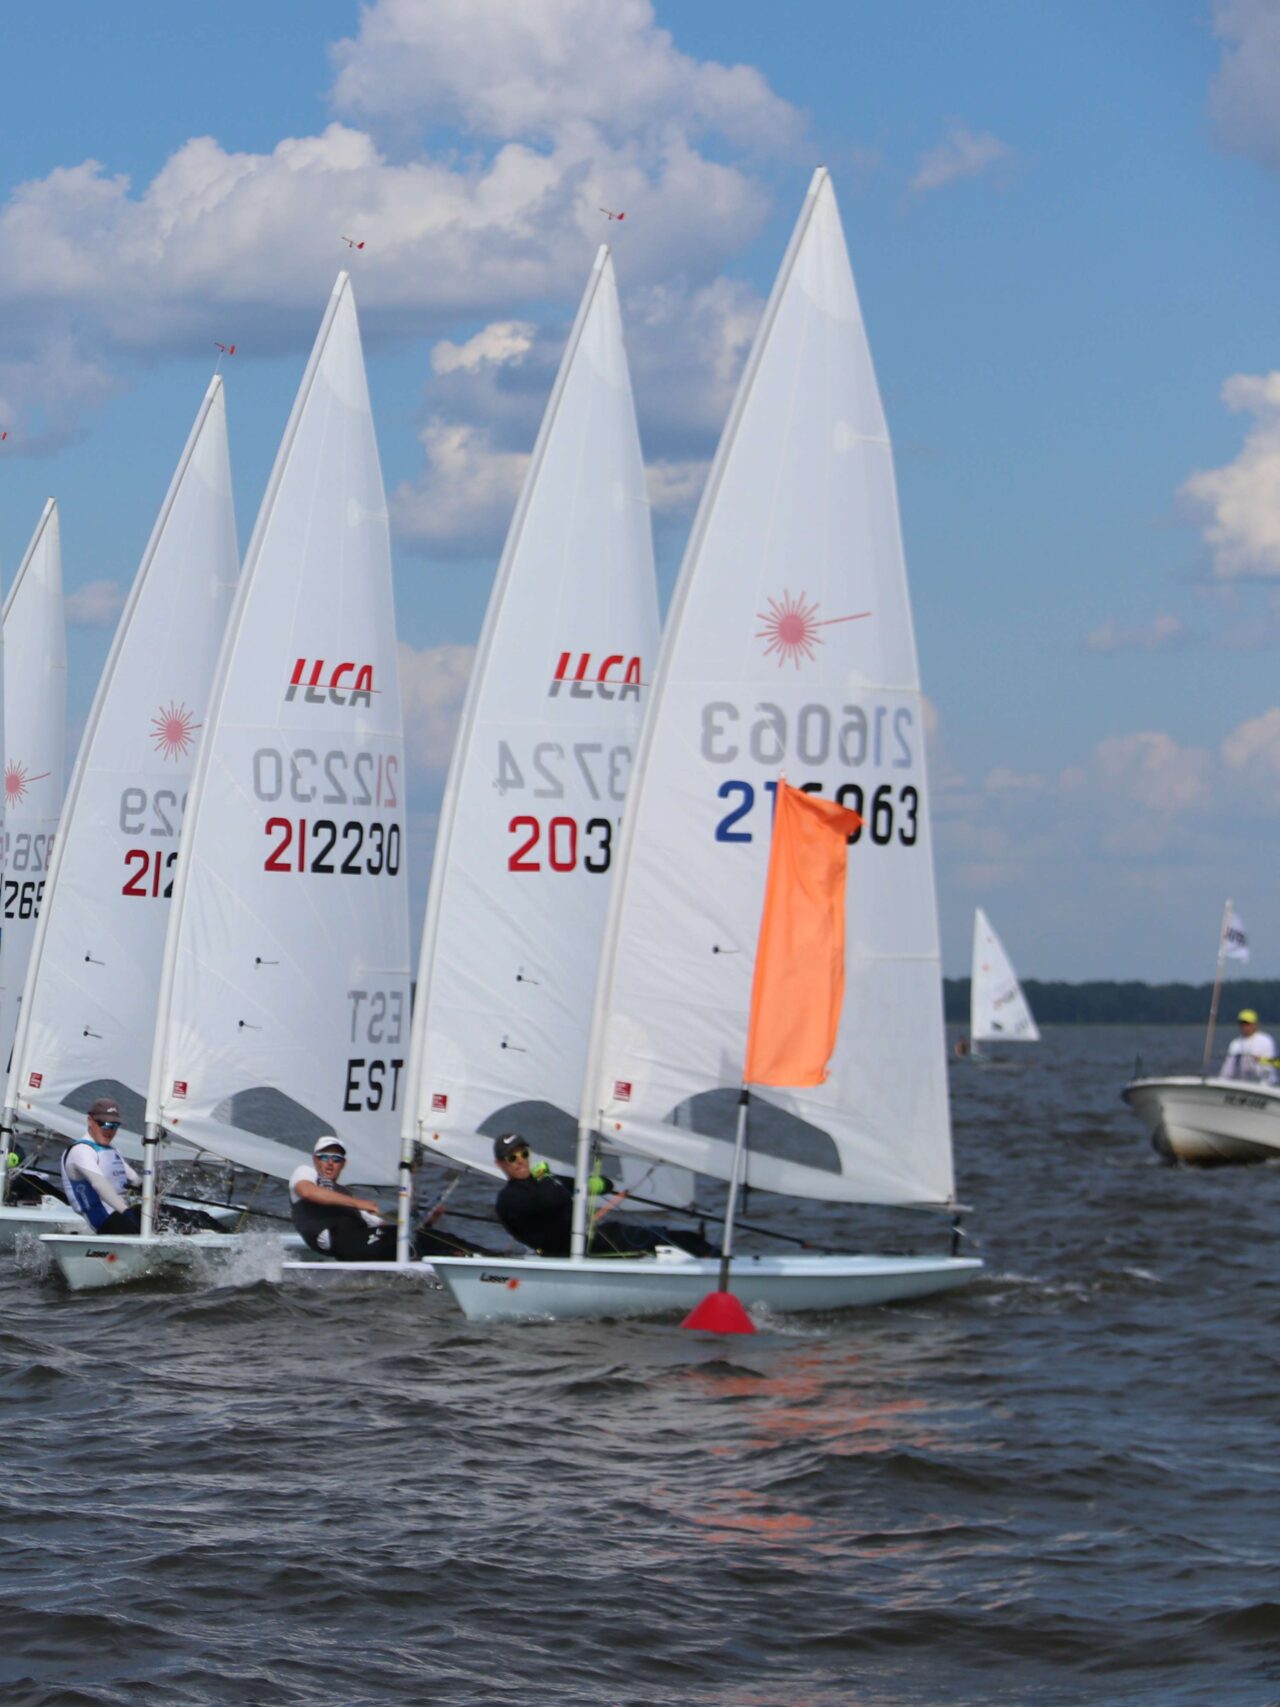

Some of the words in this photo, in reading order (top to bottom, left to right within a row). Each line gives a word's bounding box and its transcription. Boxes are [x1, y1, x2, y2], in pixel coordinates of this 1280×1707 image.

[284, 658, 373, 708] ILCA
[549, 652, 642, 702] ILCA
[715, 780, 918, 846] 2063
[264, 817, 400, 876] 212230
[508, 816, 613, 874] 203
[343, 1058, 404, 1112] EST
